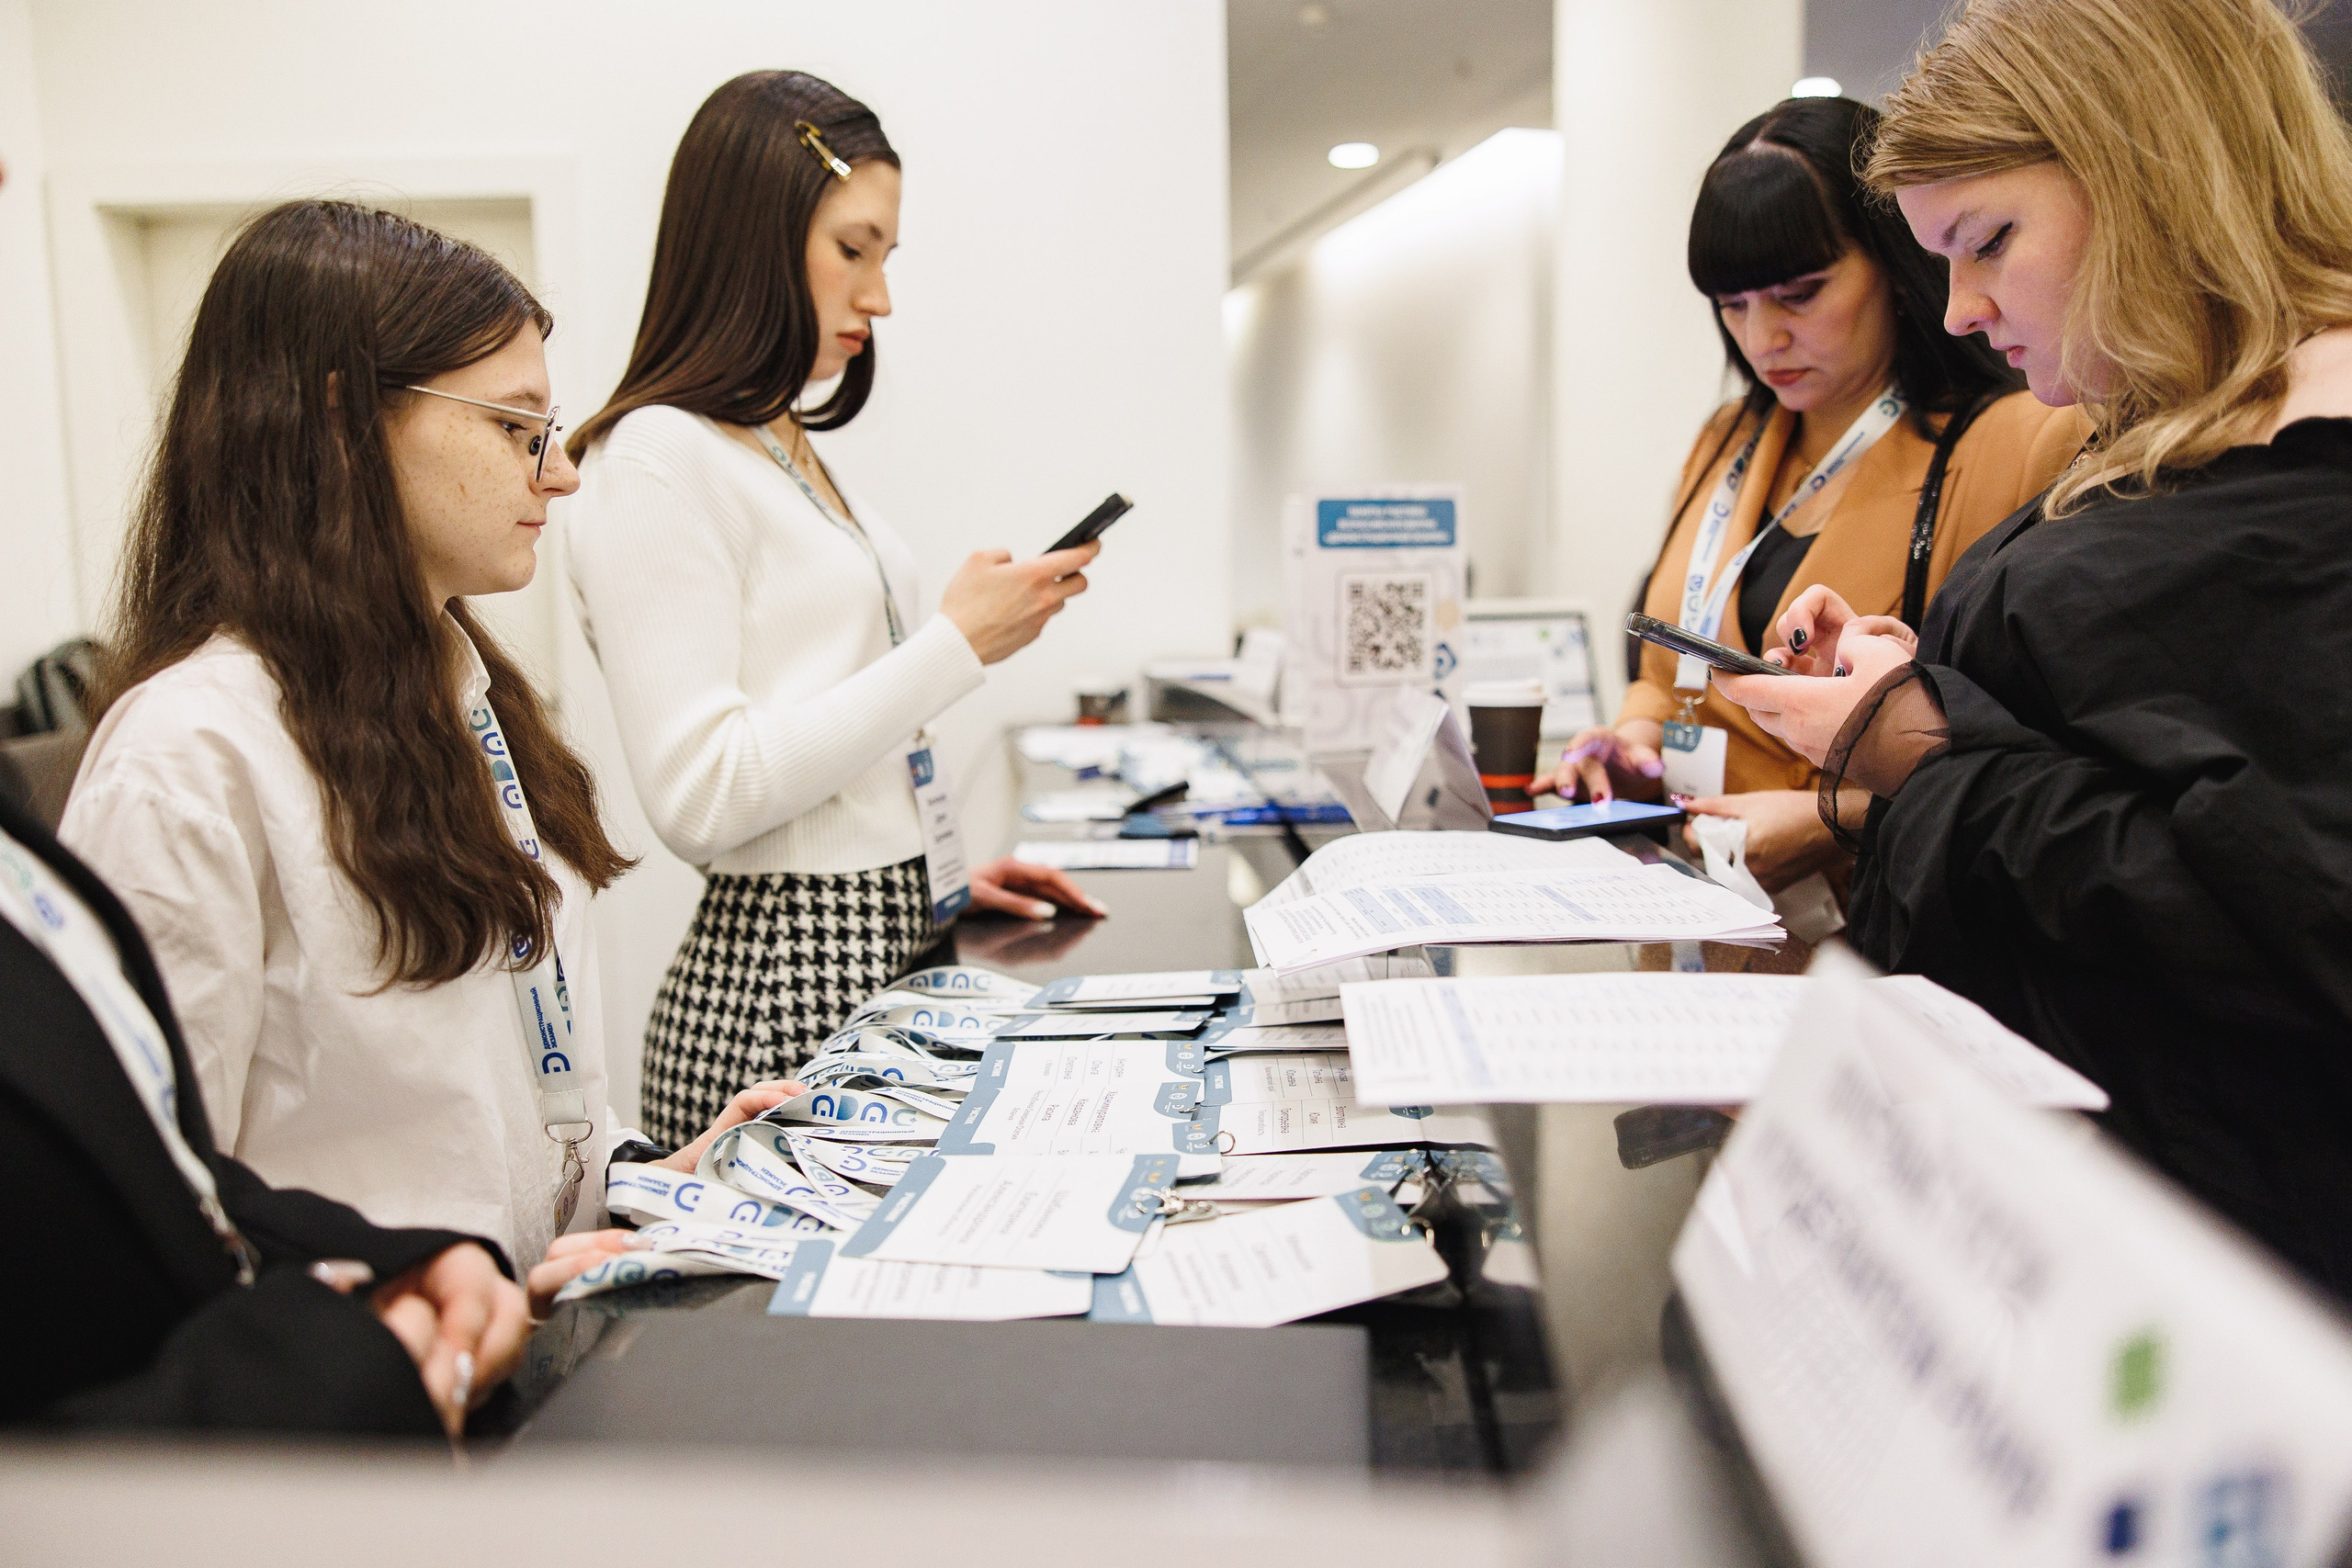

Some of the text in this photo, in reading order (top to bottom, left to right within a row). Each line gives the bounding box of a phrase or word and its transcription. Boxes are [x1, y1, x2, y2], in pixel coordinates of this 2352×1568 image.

[530, 987, 551, 1049] ДЕМОНСТРАЦИОННЫЙ
[546, 1022, 558, 1048] ЭКЗАМЕН
[1063, 1056, 1078, 1079] Олеговна
[1091, 1060, 1102, 1076] Ольга
[896, 1089, 956, 1111] ДЕМОНСТРАЦИОНН
